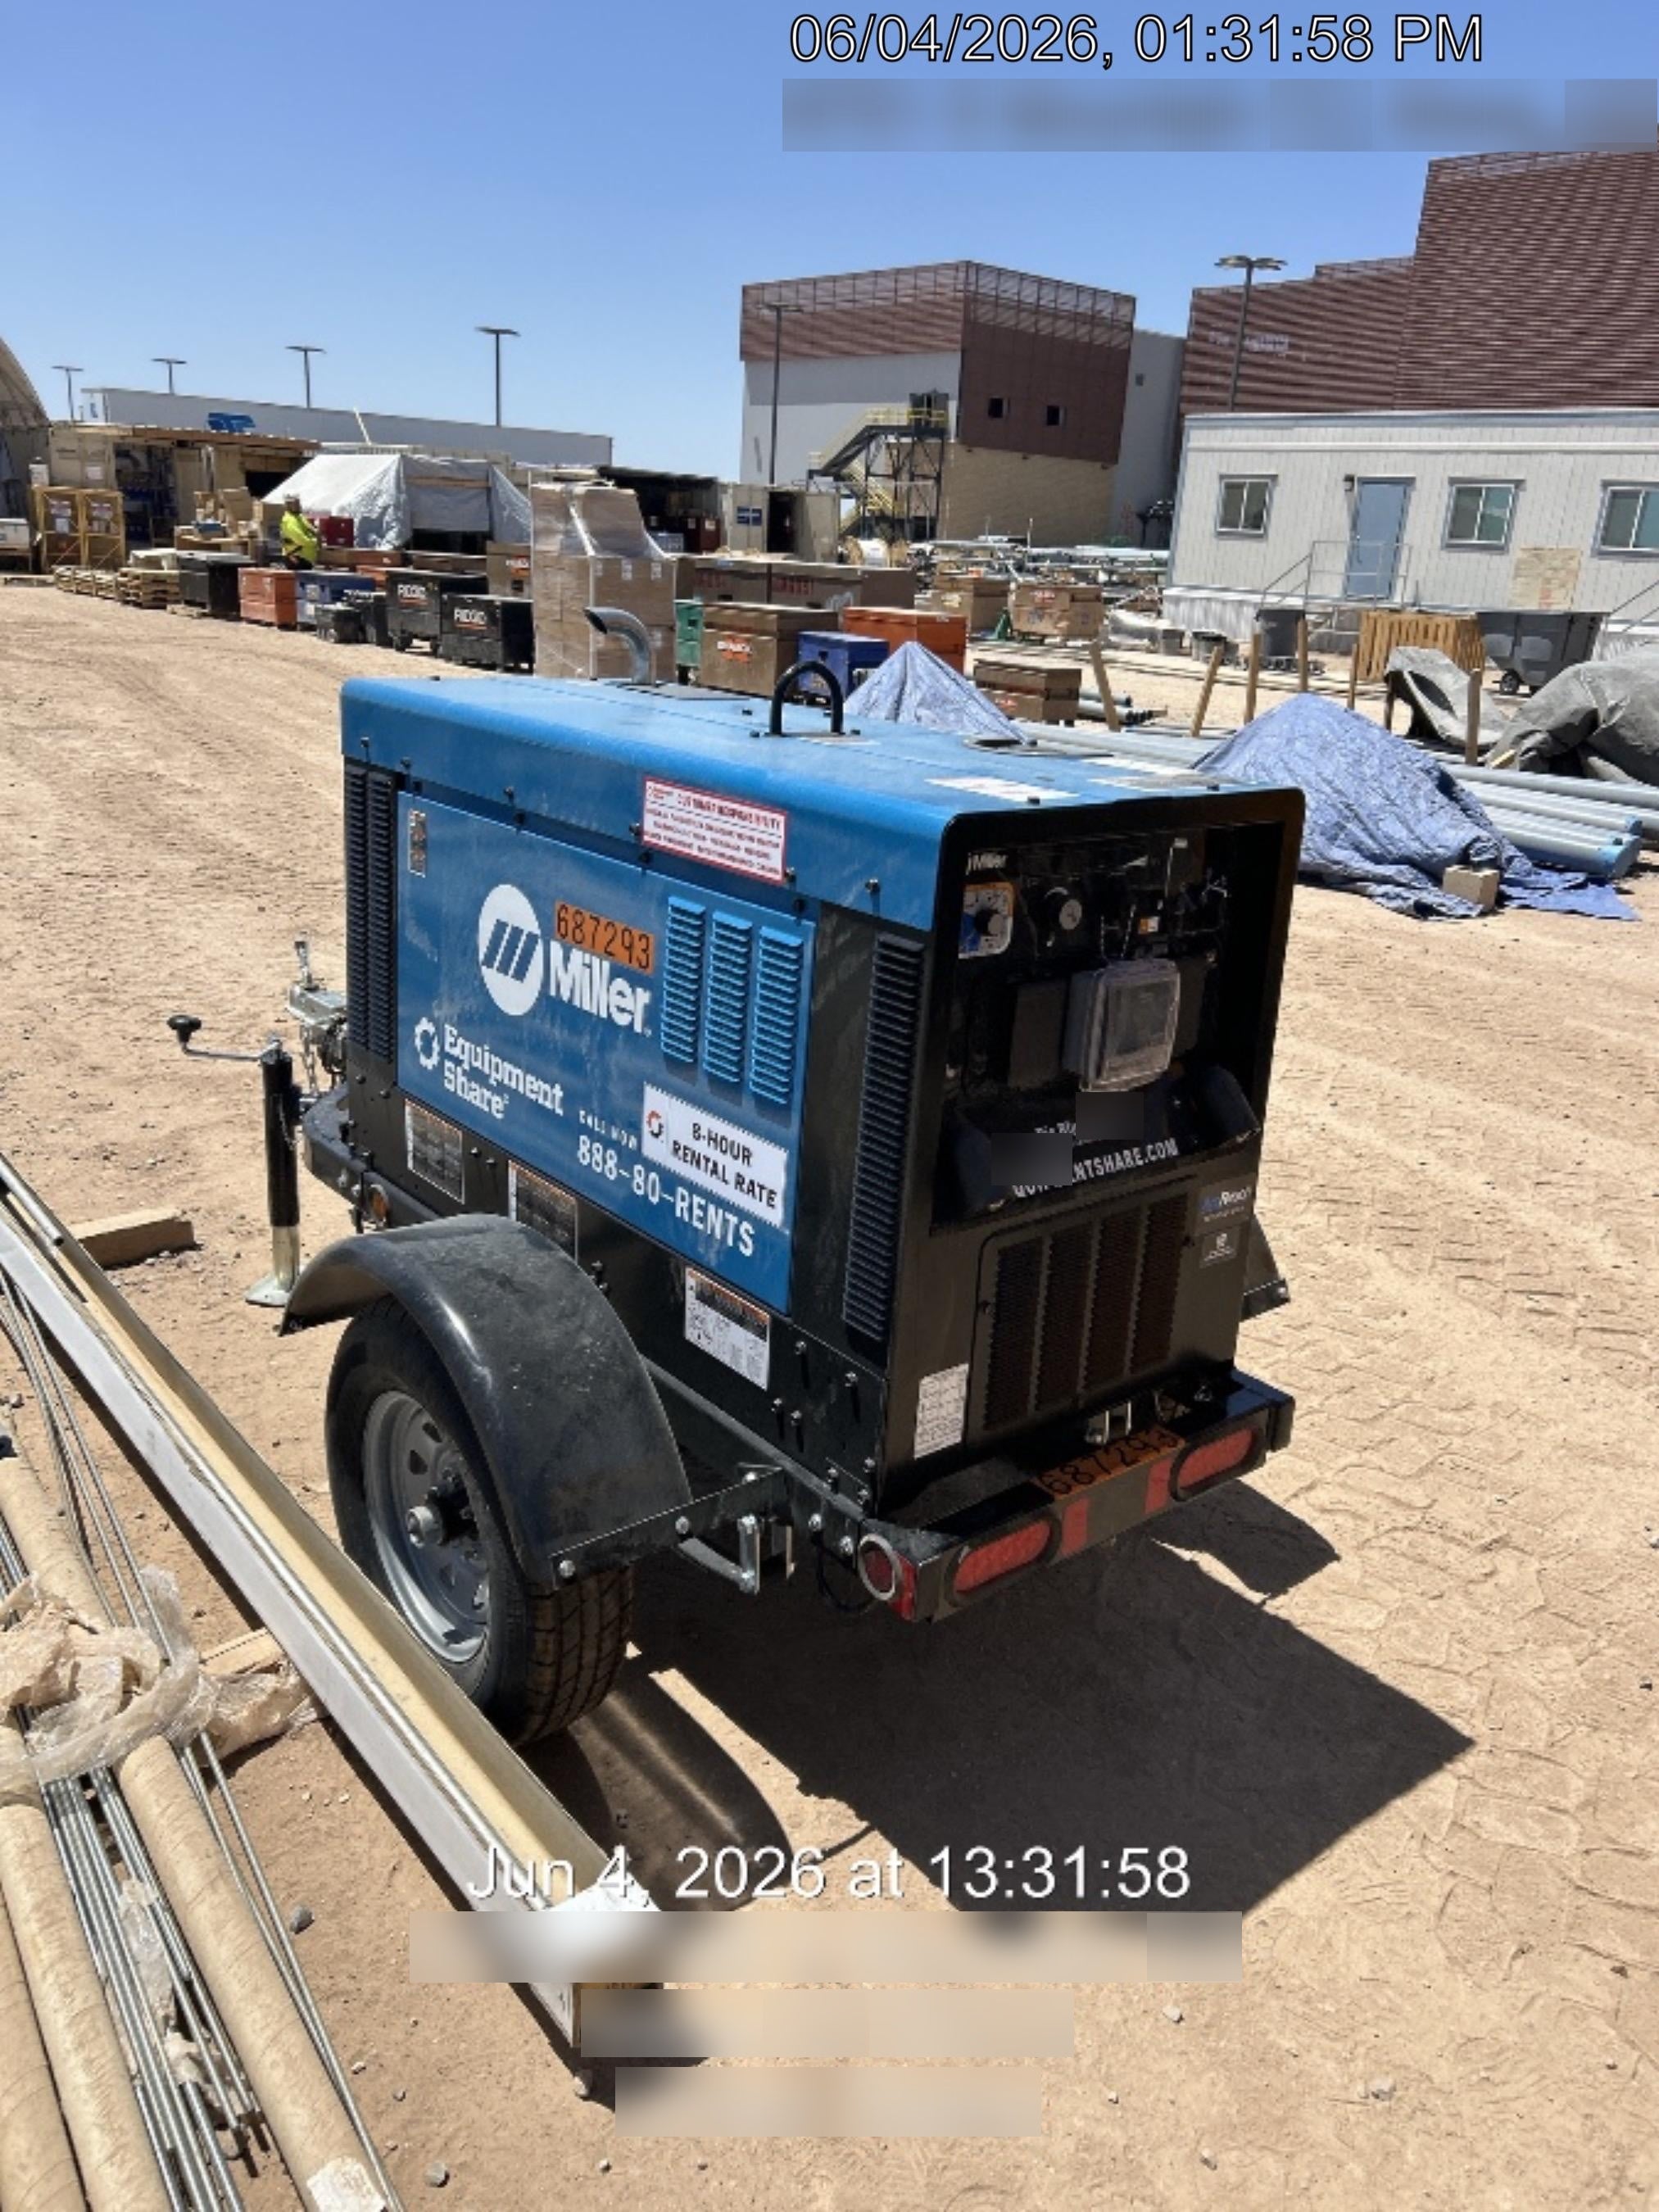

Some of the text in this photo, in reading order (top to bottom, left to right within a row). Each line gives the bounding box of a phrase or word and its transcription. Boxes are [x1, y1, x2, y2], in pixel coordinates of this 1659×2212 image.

[557, 904, 650, 970] 687293
[444, 1023, 564, 1117] Equipment
[444, 1059, 506, 1119] Share
[672, 1140, 777, 1209] RENTAL RATE
[692, 1122, 753, 1167] 8-HOUR
[578, 1135, 755, 1257] 888-80-RENTS
